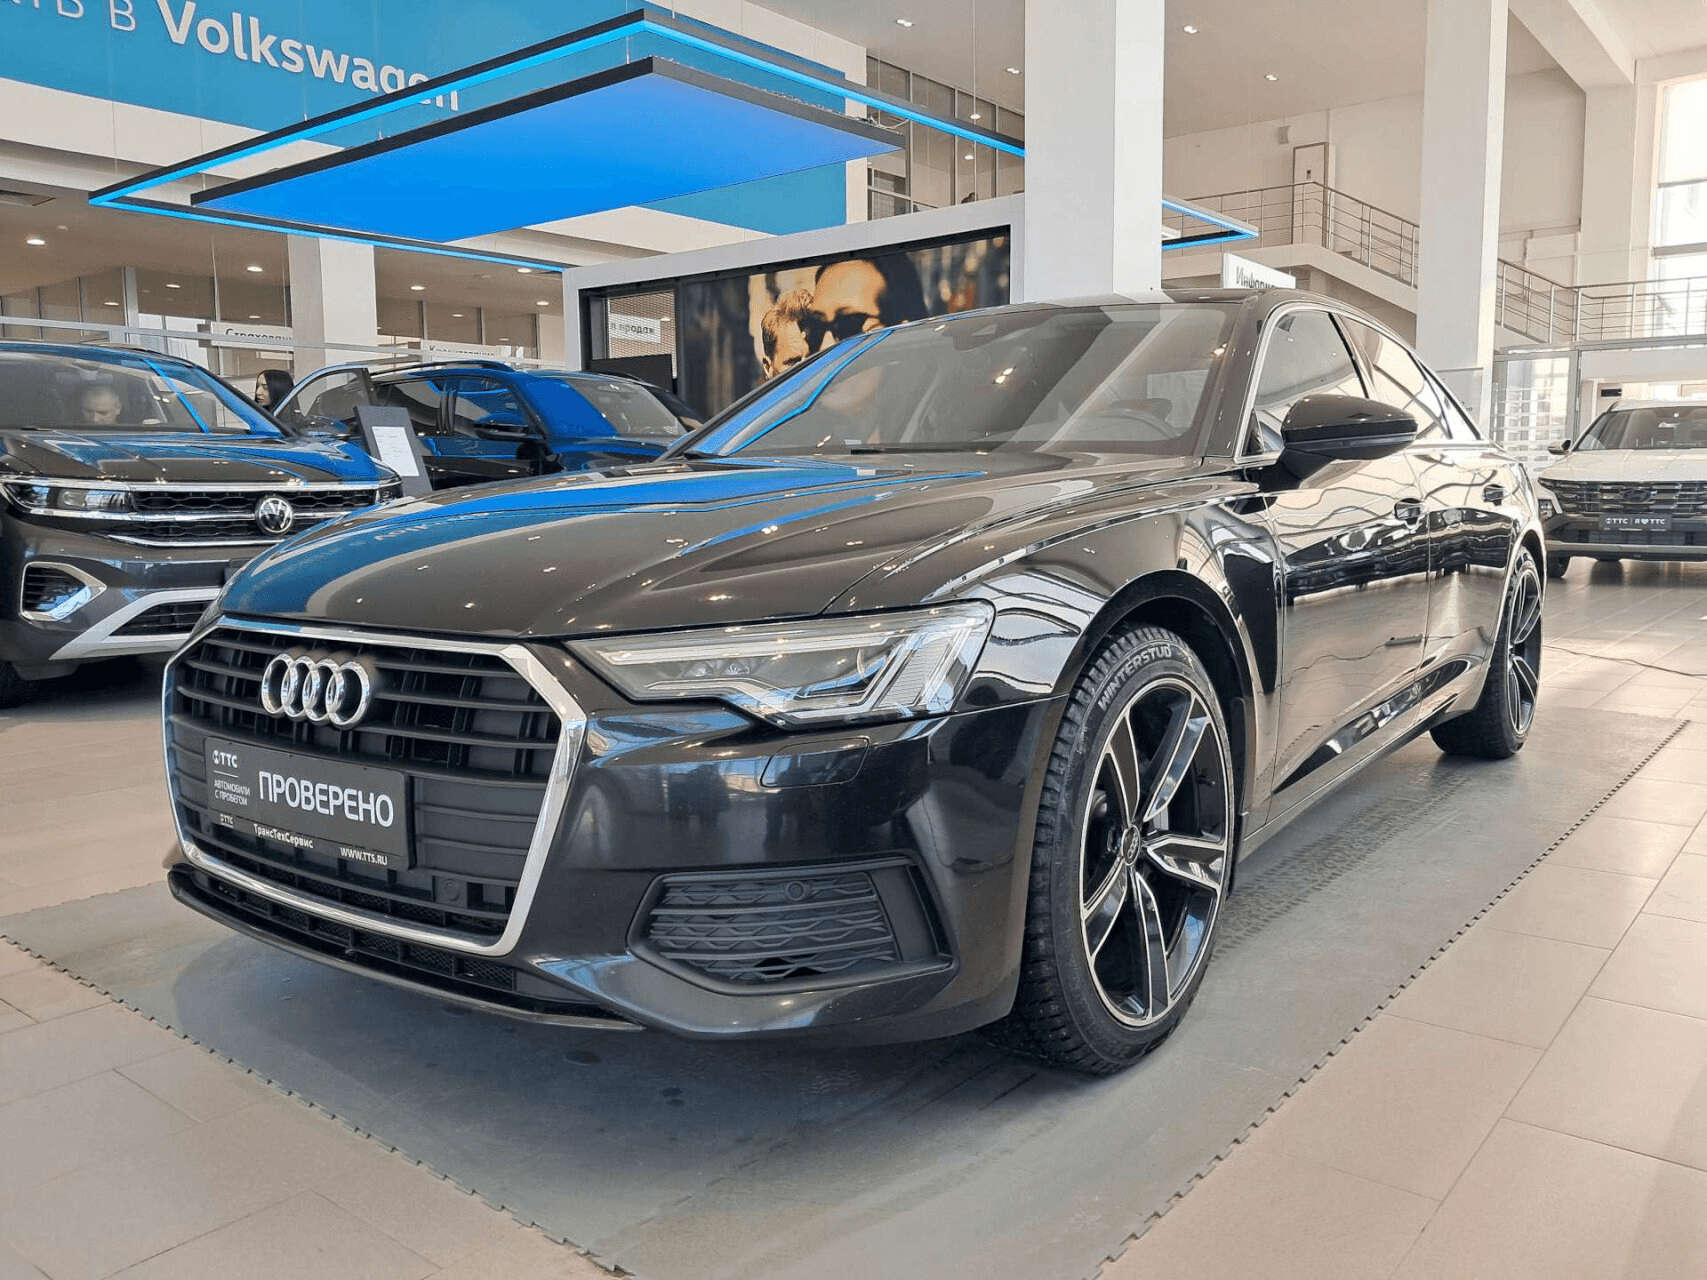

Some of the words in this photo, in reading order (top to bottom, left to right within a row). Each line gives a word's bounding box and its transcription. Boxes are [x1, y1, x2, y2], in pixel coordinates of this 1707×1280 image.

[1097, 643, 1172, 712] WINTERSTUD
[220, 752, 238, 769] ТТС
[214, 779, 251, 797] АВТОМОБИЛИ
[219, 791, 248, 806] ПРОБЕГОМ
[258, 770, 394, 828] ПРОВЕРЕНО
[253, 823, 314, 849] ТрансТехСервис
[339, 847, 389, 866] WWW.TTS.RU
